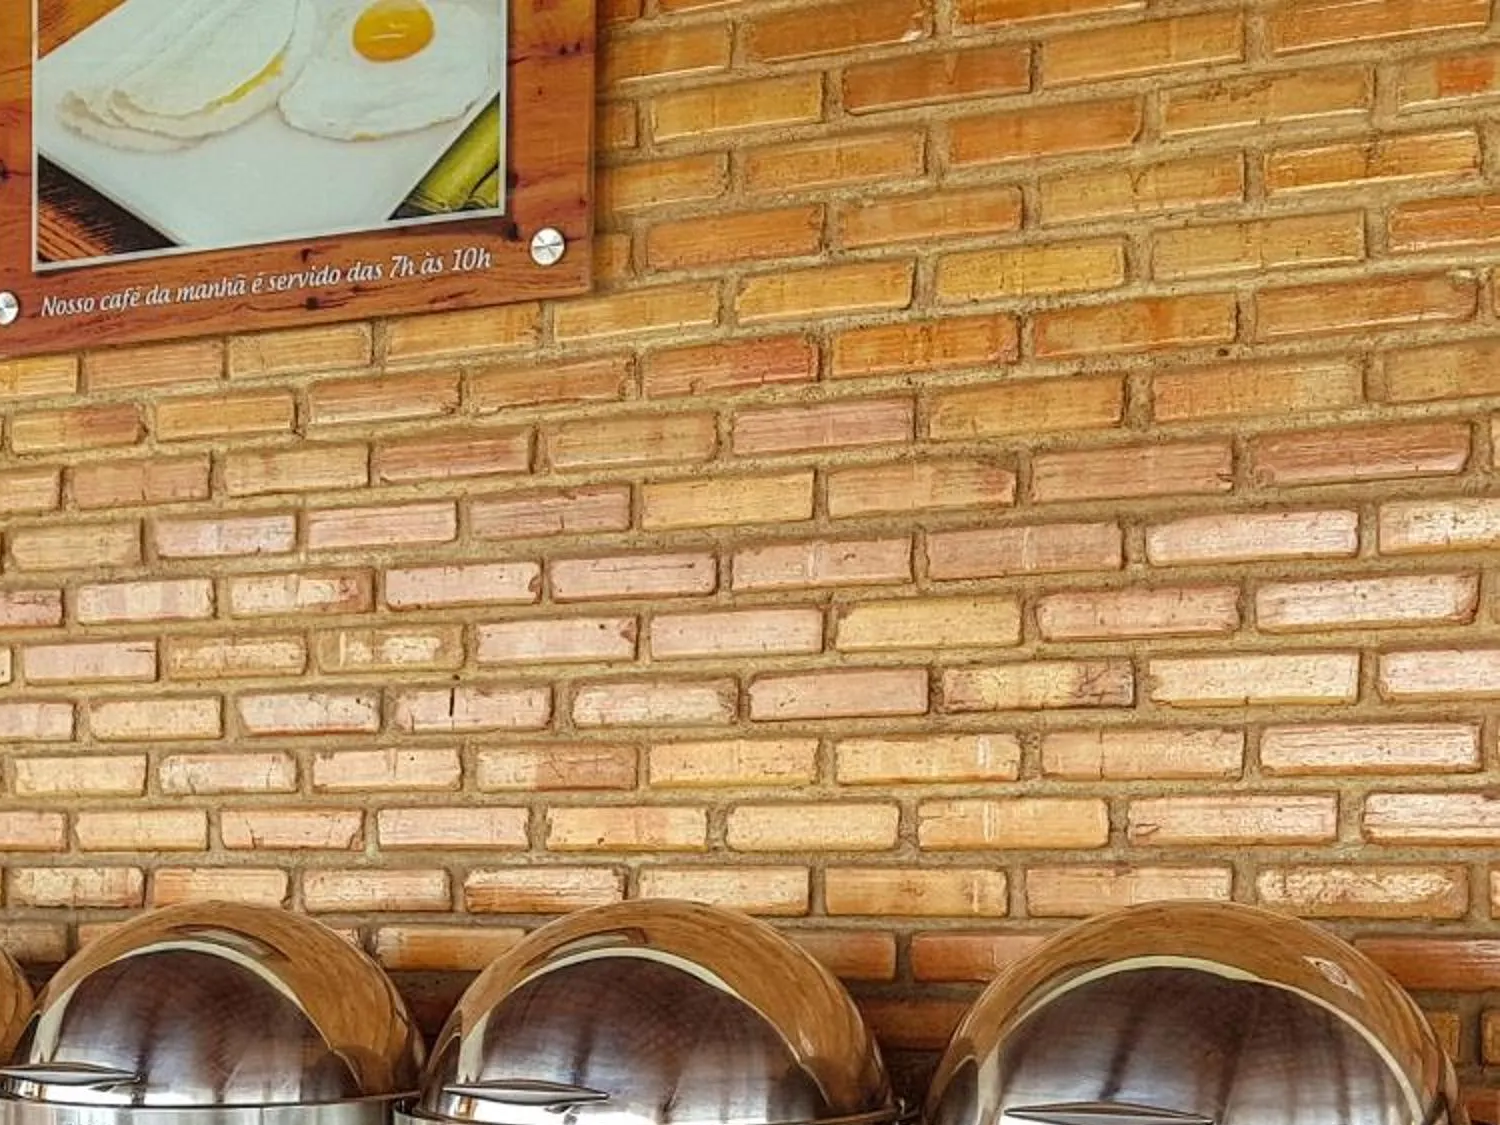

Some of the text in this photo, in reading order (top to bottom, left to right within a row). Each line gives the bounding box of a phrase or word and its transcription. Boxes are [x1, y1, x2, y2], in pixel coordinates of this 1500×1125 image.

[41, 247, 492, 317] Nosso café da manhã é servido das 7h às 10h
